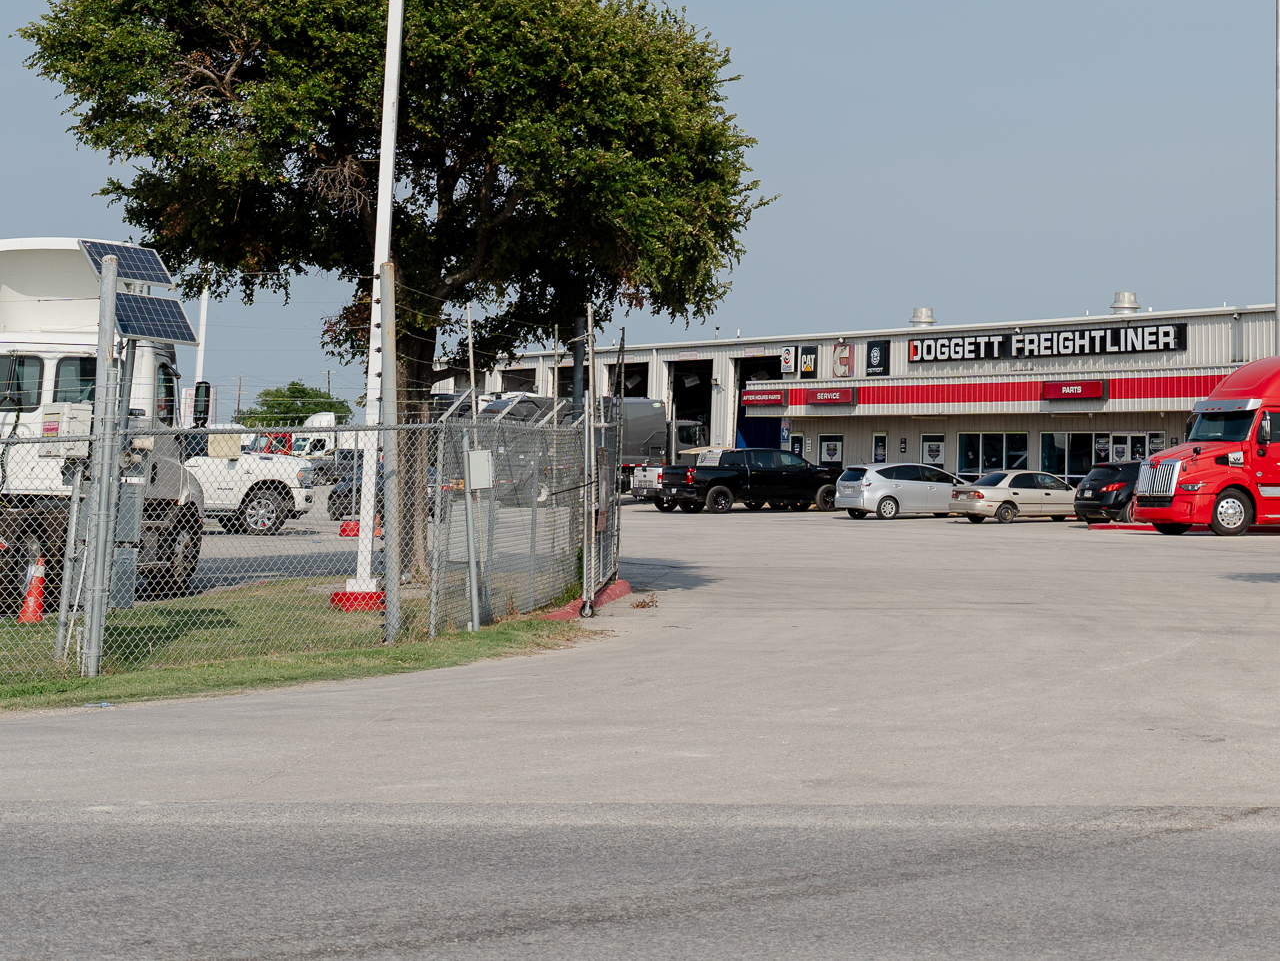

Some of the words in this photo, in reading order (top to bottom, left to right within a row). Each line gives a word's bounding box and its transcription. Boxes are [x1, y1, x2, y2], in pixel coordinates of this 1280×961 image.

[909, 336, 1003, 361] DOGGETT
[1011, 326, 1176, 357] FREIGHTLINER
[802, 354, 815, 372] CAT
[817, 392, 840, 400] SERVICE
[1062, 386, 1082, 394] PARTS
